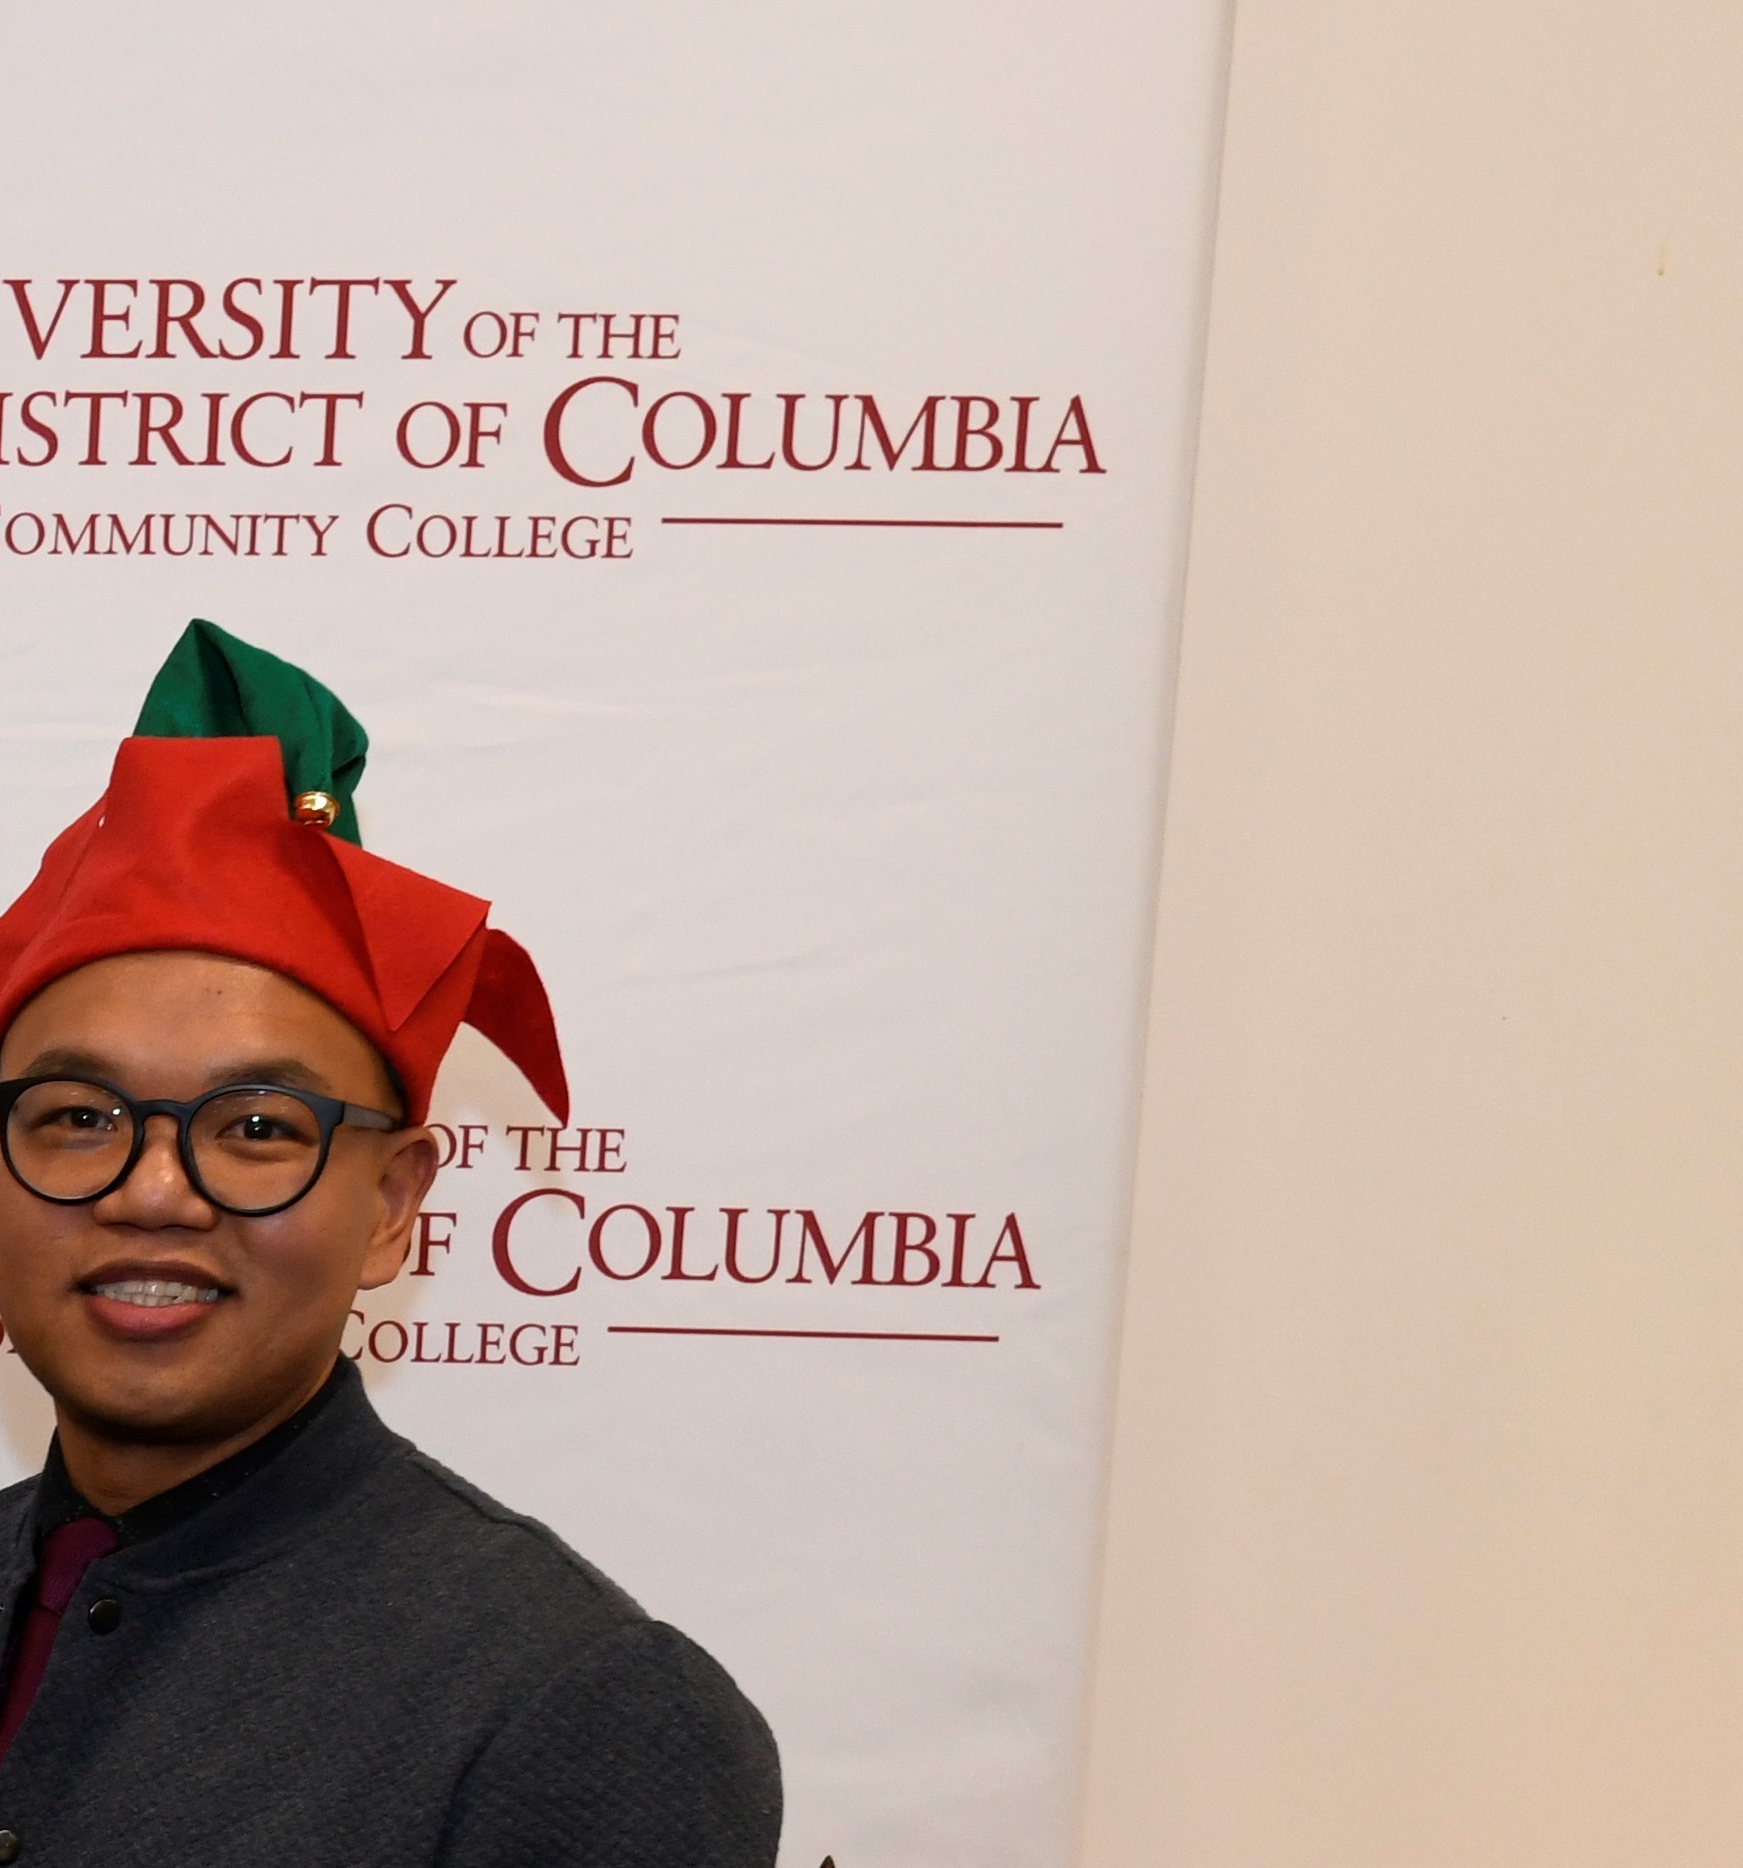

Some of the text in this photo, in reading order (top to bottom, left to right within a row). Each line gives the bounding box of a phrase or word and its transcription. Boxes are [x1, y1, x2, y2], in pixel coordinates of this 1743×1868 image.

[463, 312, 539, 360] OF
[558, 313, 681, 360] THE
[396, 401, 508, 469] OF
[543, 376, 1106, 488] COLUMBIA
[366, 504, 634, 560] COLLEGE
[505, 1124, 628, 1173] THE
[491, 1187, 1042, 1297] COLUMBIA
